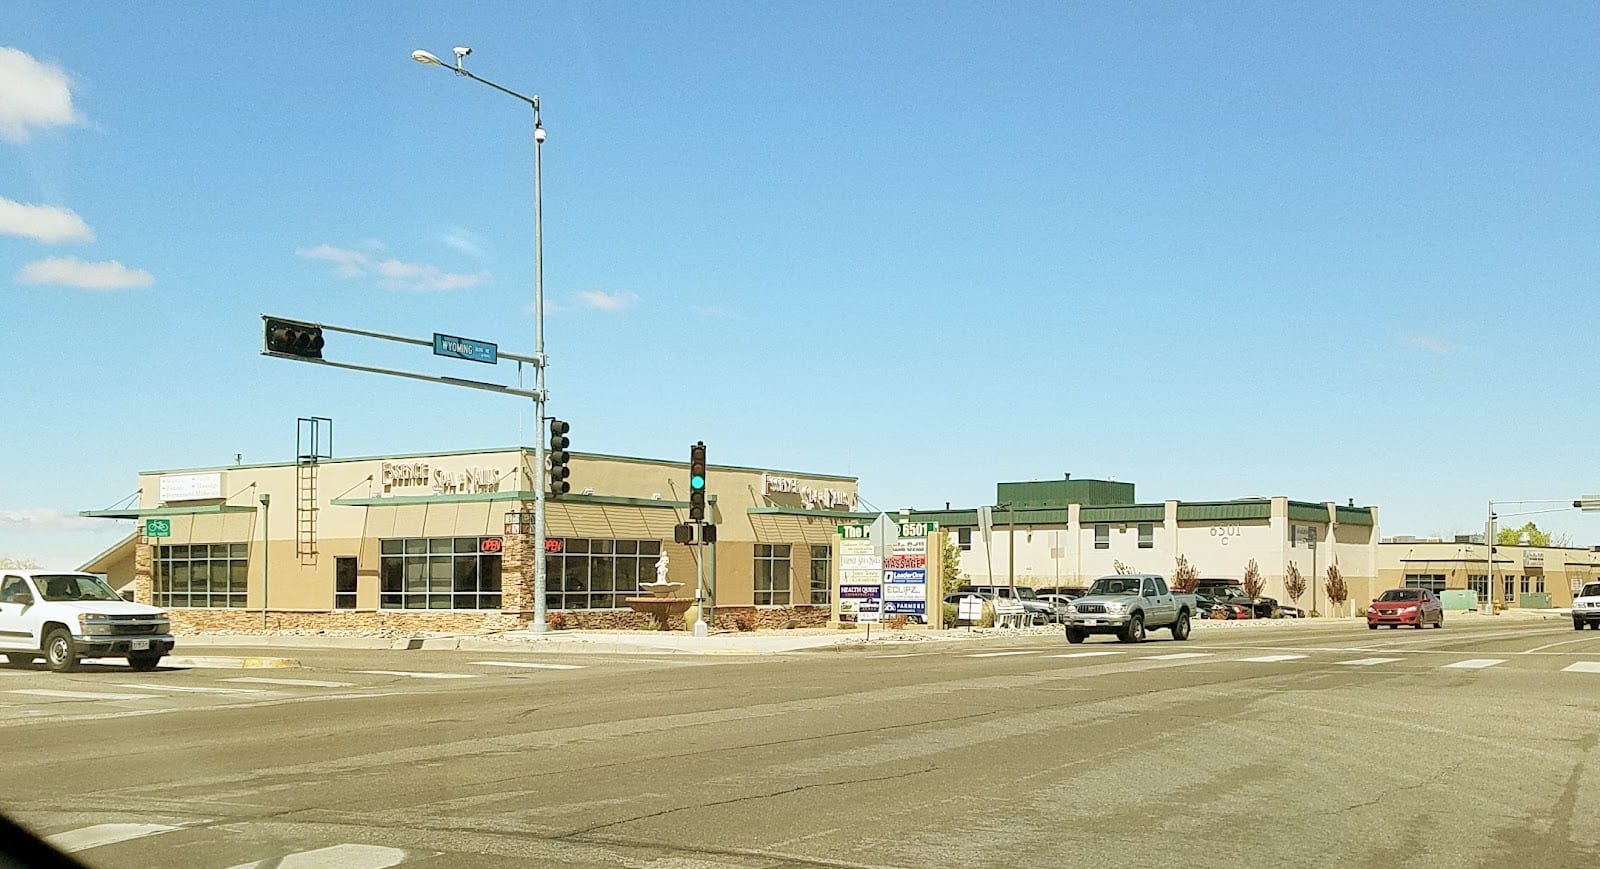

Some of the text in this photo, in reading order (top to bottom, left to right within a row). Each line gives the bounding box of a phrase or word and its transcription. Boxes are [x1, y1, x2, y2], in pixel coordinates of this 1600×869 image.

[442, 340, 473, 355] WYOMING
[382, 462, 429, 485] ESSENCE
[844, 525, 862, 539] The
[903, 524, 928, 537] 6501
[1210, 523, 1241, 537] 6501
[482, 540, 501, 552] OPEN
[884, 558, 920, 569] MASSAGE
[894, 571, 924, 579] LeaderOne
[861, 586, 880, 594] QUEST
